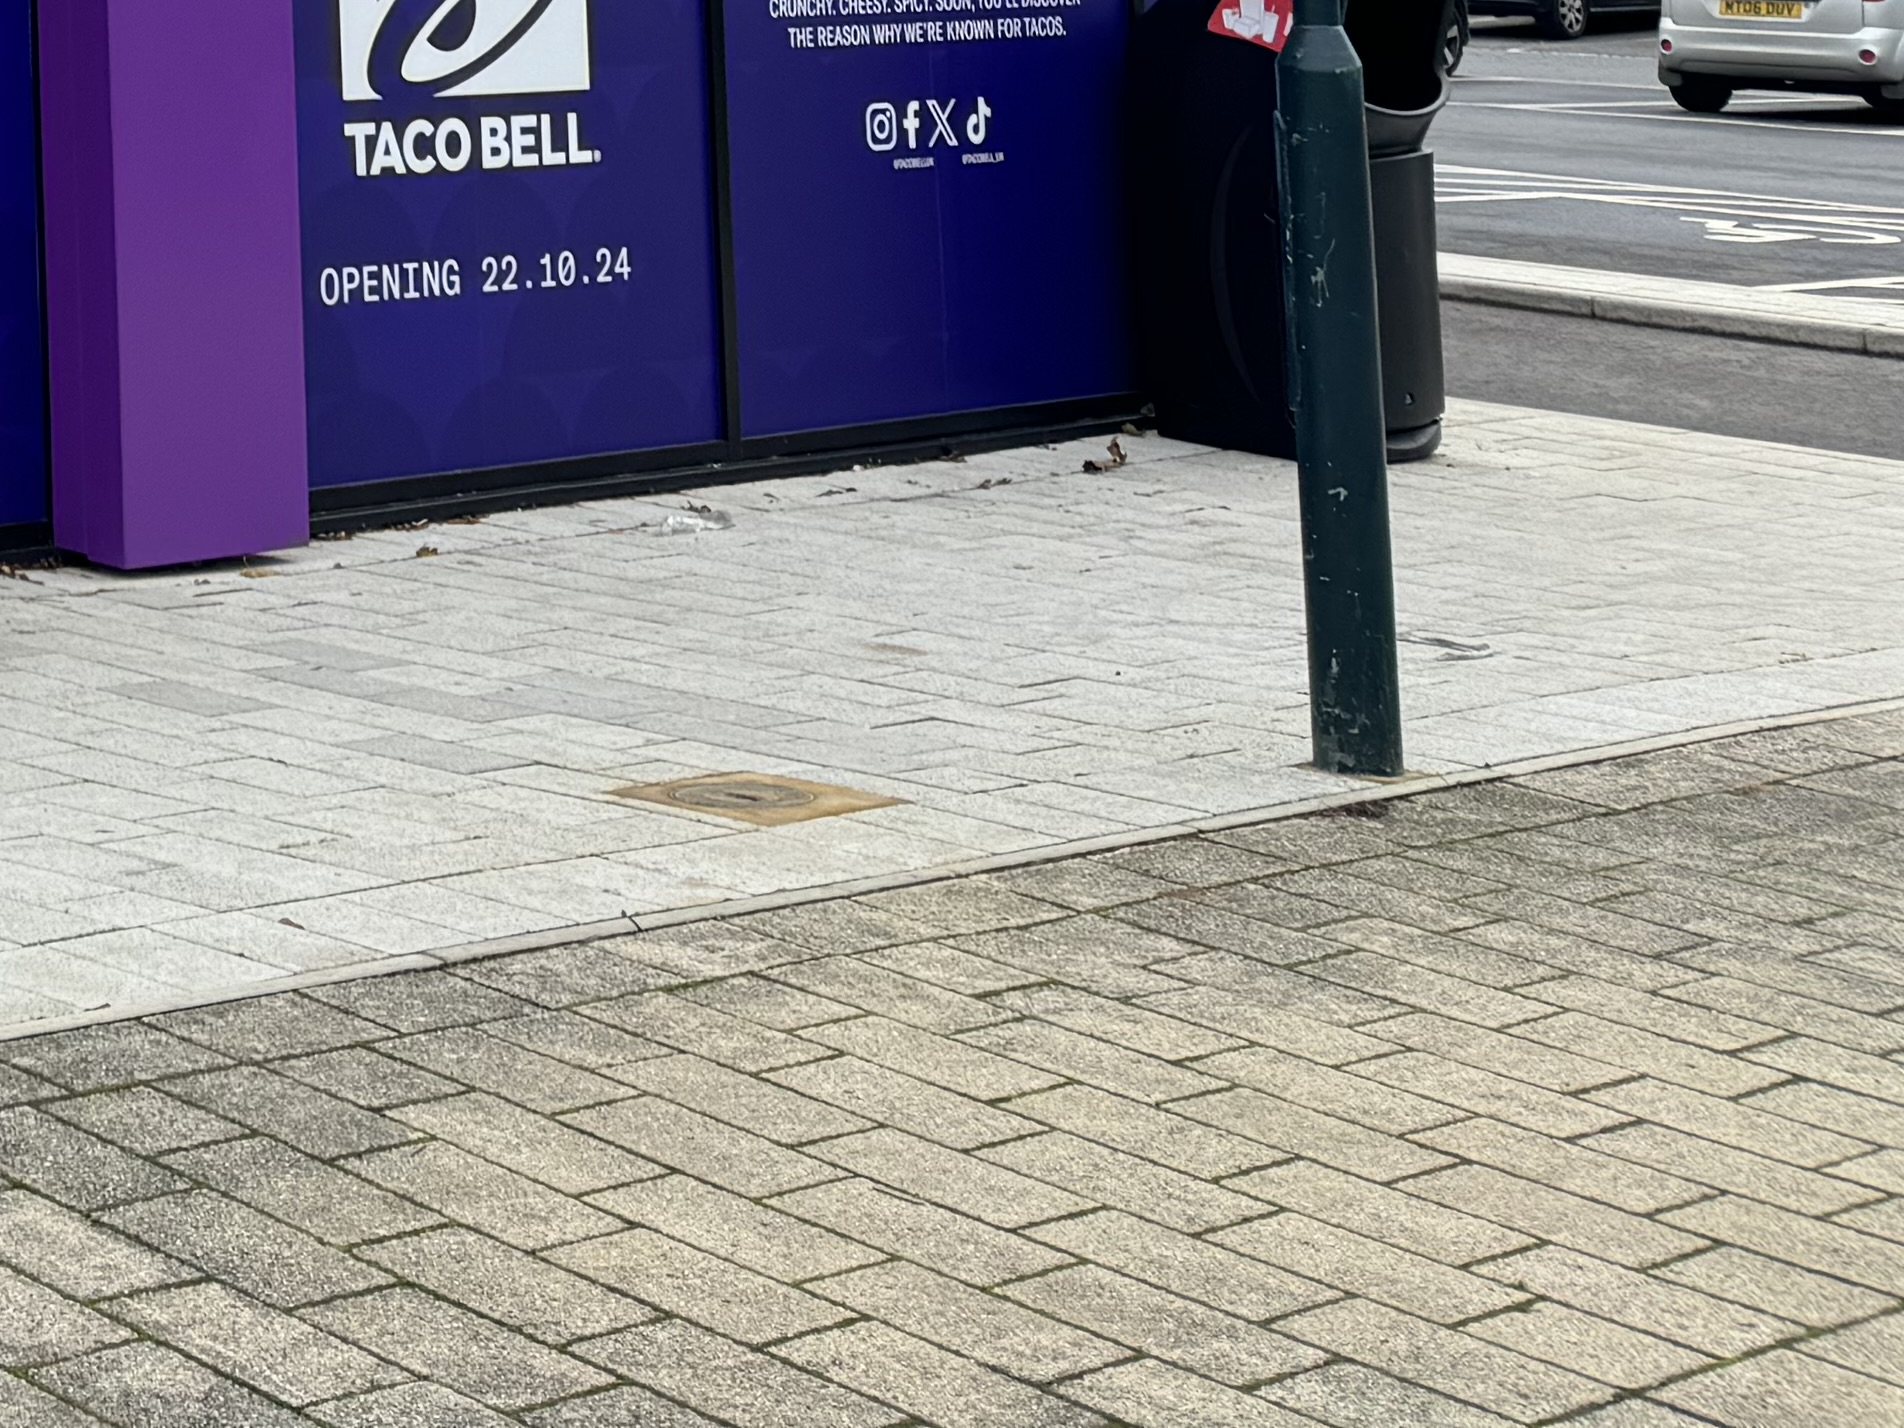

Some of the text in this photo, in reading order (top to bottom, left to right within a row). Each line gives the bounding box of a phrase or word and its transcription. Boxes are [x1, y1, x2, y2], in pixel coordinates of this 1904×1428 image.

[788, 26, 815, 48] THE
[817, 24, 871, 47] REASON
[873, 23, 903, 45] WHY
[946, 19, 995, 41] KNOWN
[997, 17, 1022, 39] FOR
[1023, 15, 1067, 38] TACOS.
[343, 117, 472, 177] TACO
[320, 246, 632, 306] OPENING 22.10.24
